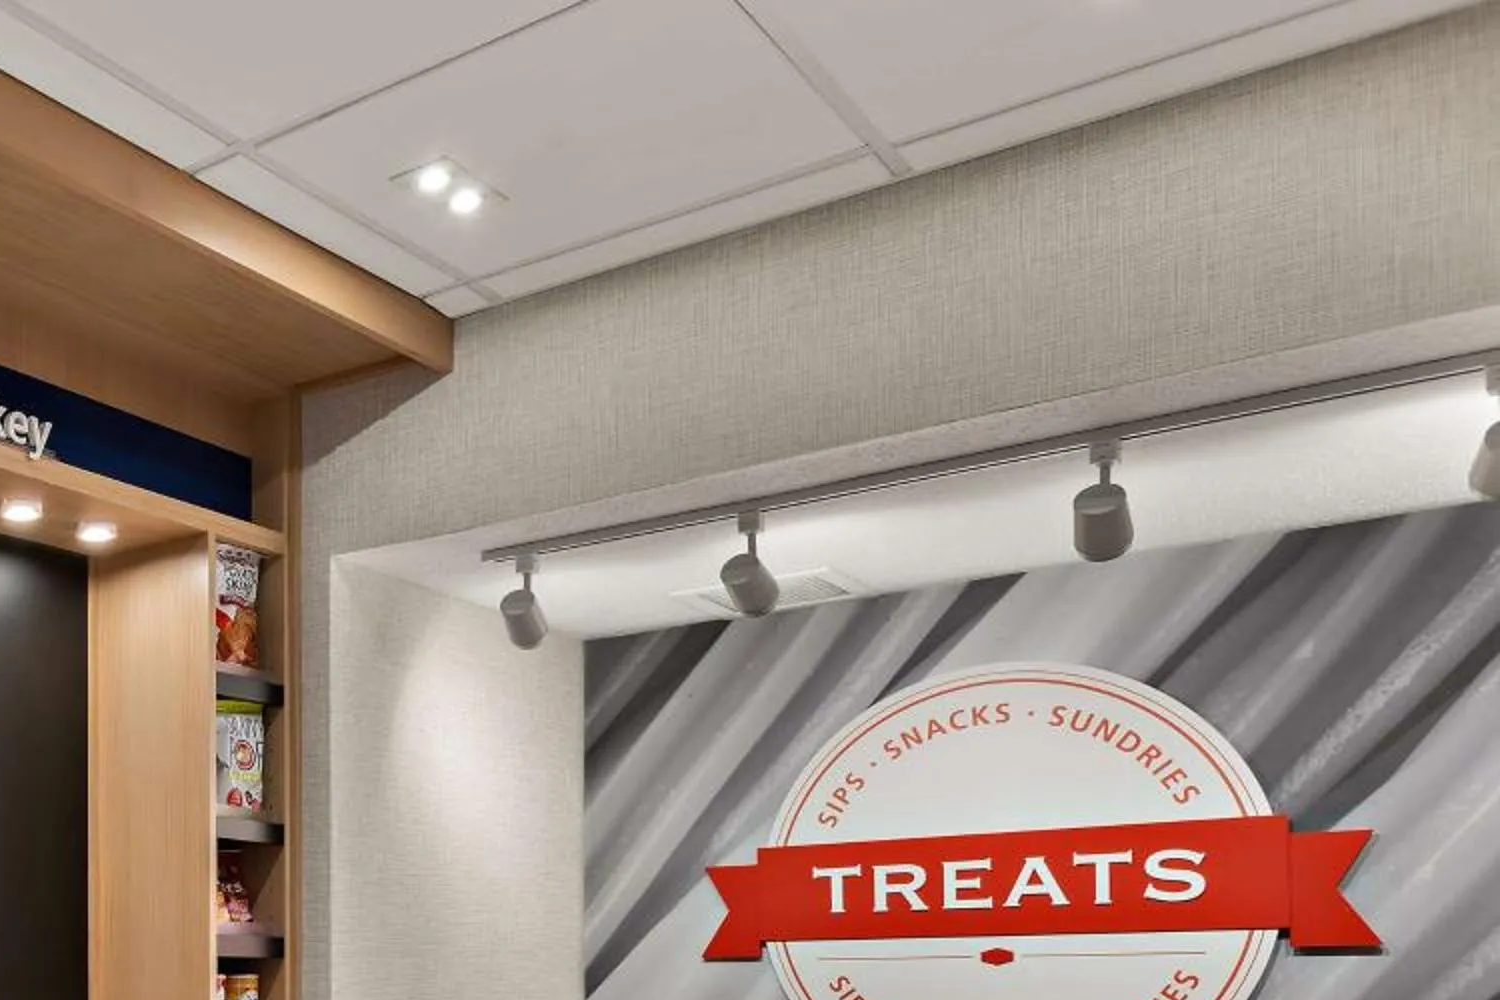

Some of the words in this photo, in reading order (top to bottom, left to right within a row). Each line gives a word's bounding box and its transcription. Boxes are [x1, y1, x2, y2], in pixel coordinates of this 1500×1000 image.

[818, 772, 865, 829] SIPS
[883, 703, 1011, 761] SNACKS
[1047, 705, 1202, 806] SUNDRIES
[811, 848, 1208, 914] TREATS
